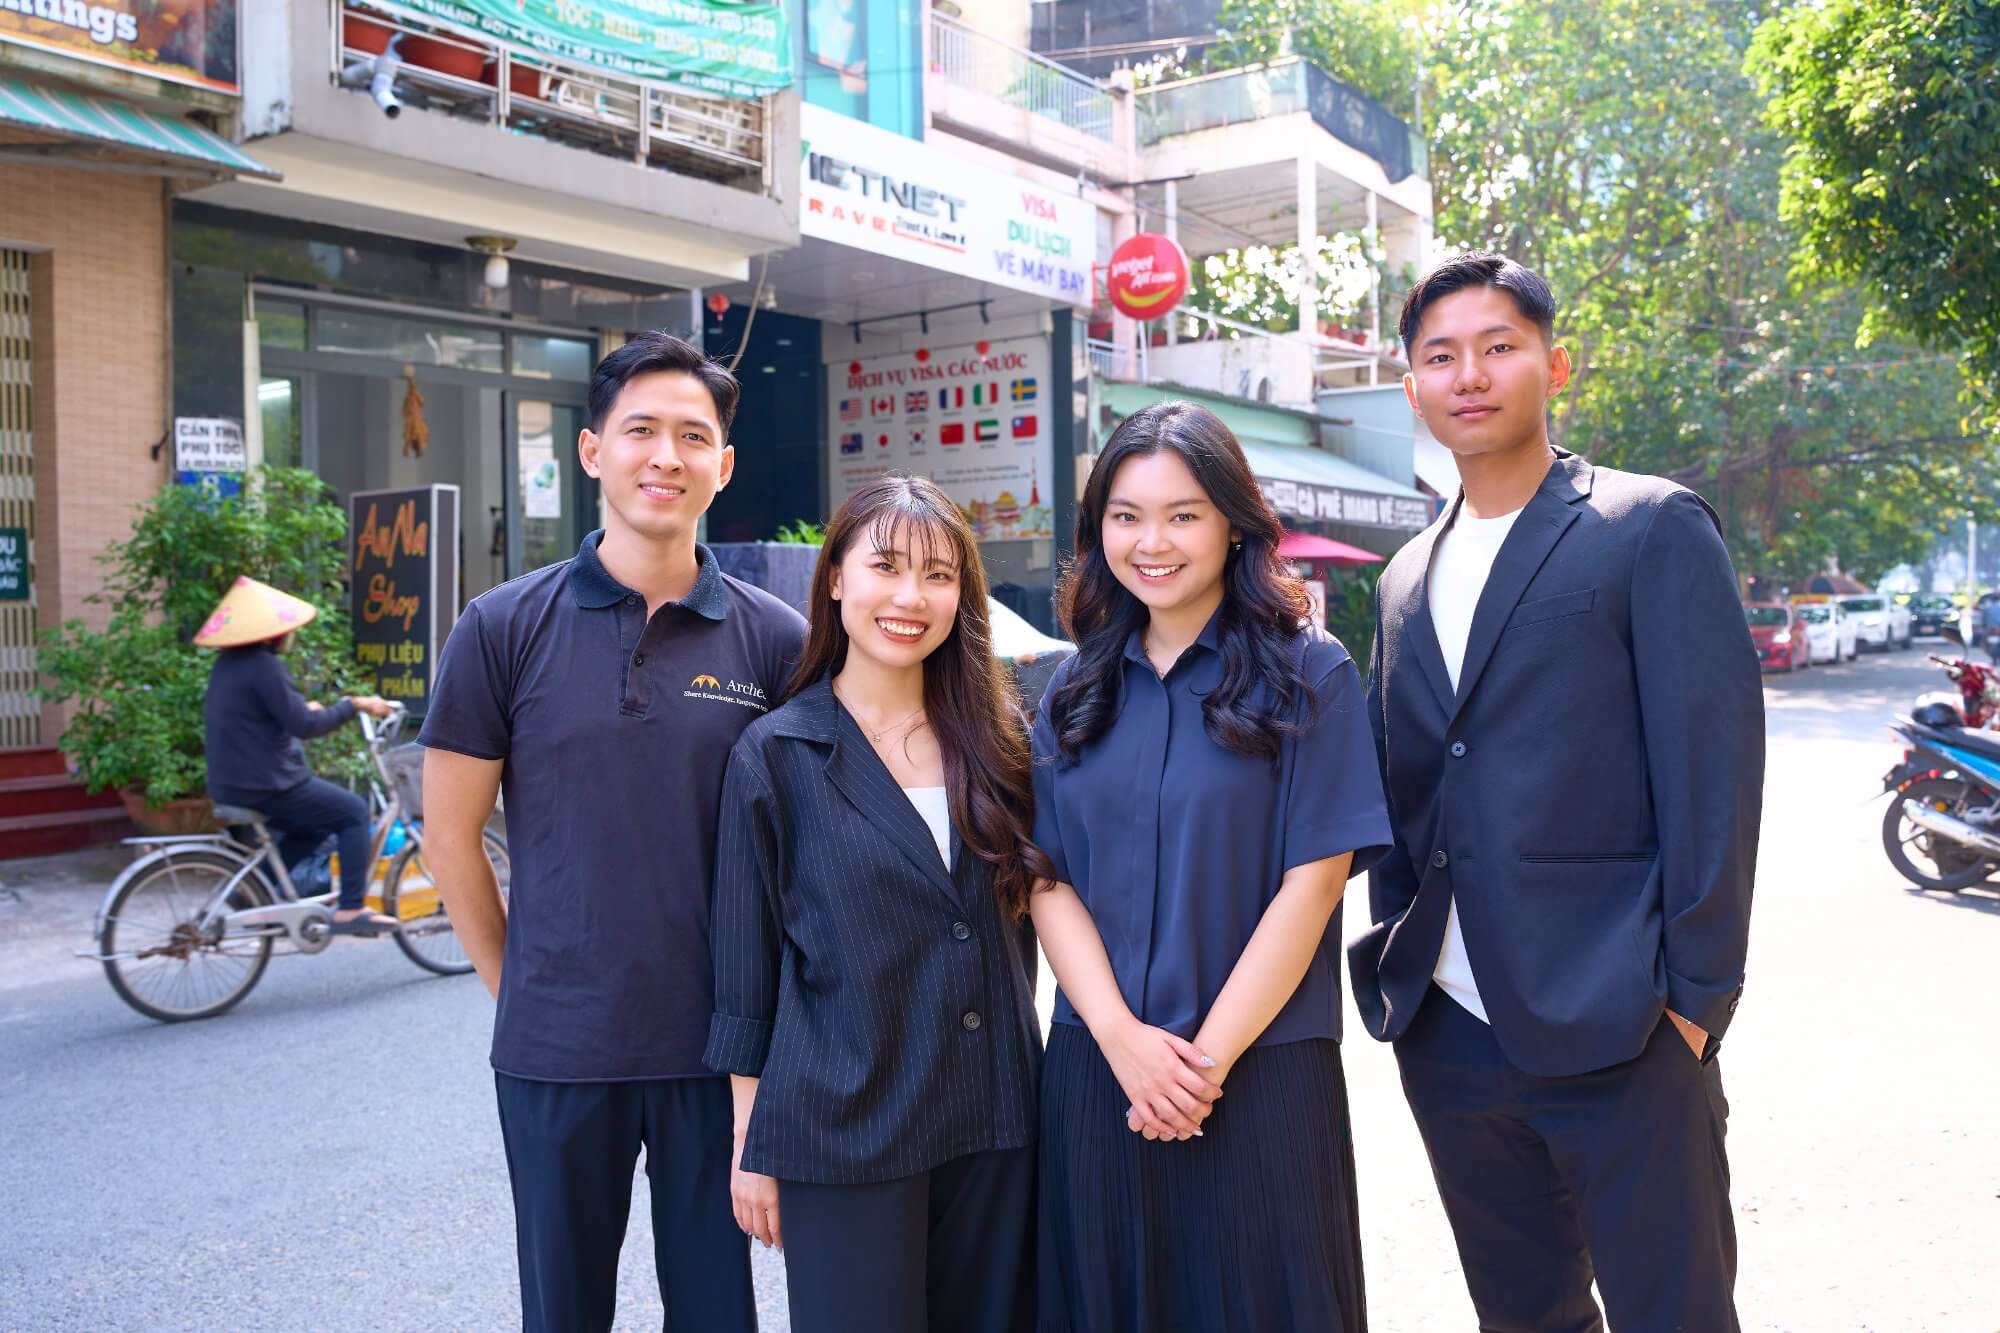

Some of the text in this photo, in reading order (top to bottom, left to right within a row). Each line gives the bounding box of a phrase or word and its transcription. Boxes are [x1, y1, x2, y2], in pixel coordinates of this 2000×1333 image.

[1021, 191, 1057, 223] VISA
[1007, 219, 1072, 257] DU LỊCH
[1059, 268, 1086, 295] BAY
[848, 371, 883, 391] DỊCH
[910, 366, 944, 382] VISA
[948, 360, 979, 378] CÁC
[1316, 489, 1342, 520] PHÊ
[356, 639, 425, 668] PHỤ LIỆU
[683, 690, 702, 698] Share
[702, 692, 736, 704] Knowledge,
